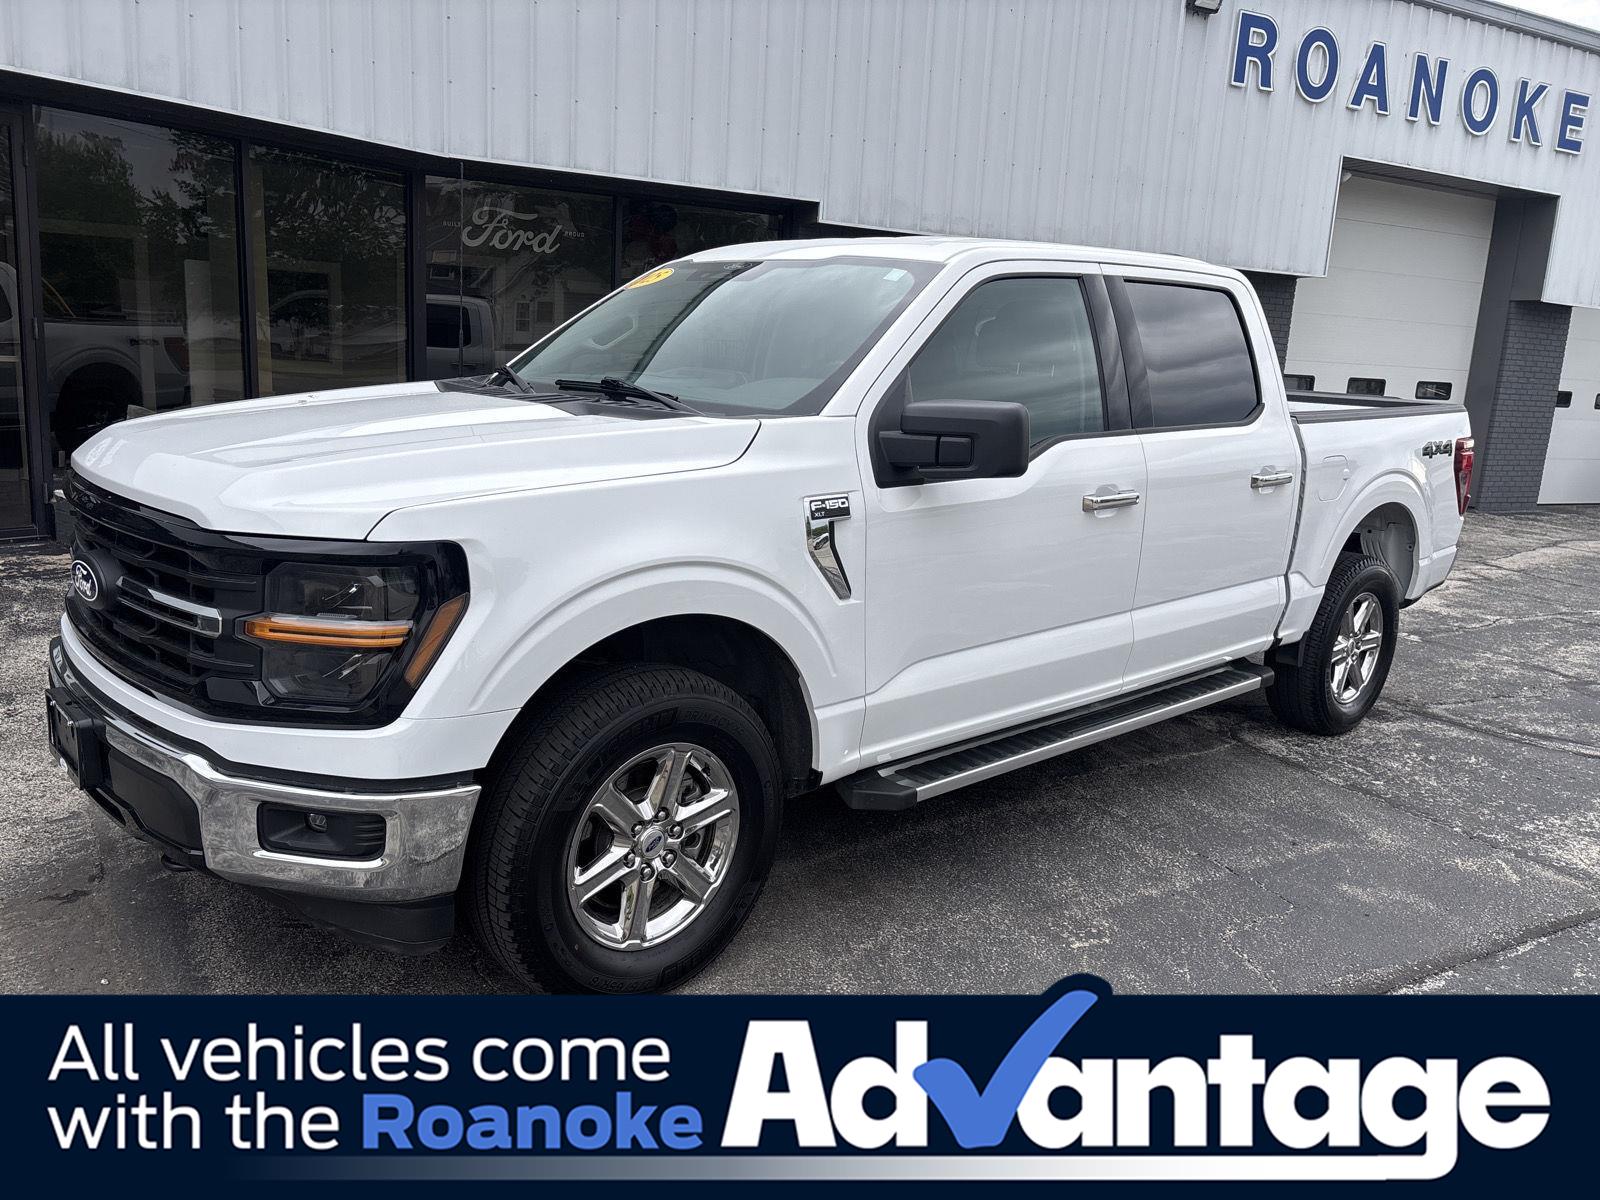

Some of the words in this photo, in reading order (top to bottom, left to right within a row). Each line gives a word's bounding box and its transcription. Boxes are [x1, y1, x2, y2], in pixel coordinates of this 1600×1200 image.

[1230, 9, 1592, 155] ROANOKE
[462, 206, 563, 254] Ford
[810, 498, 849, 511] F-150
[74, 563, 93, 597] Ford
